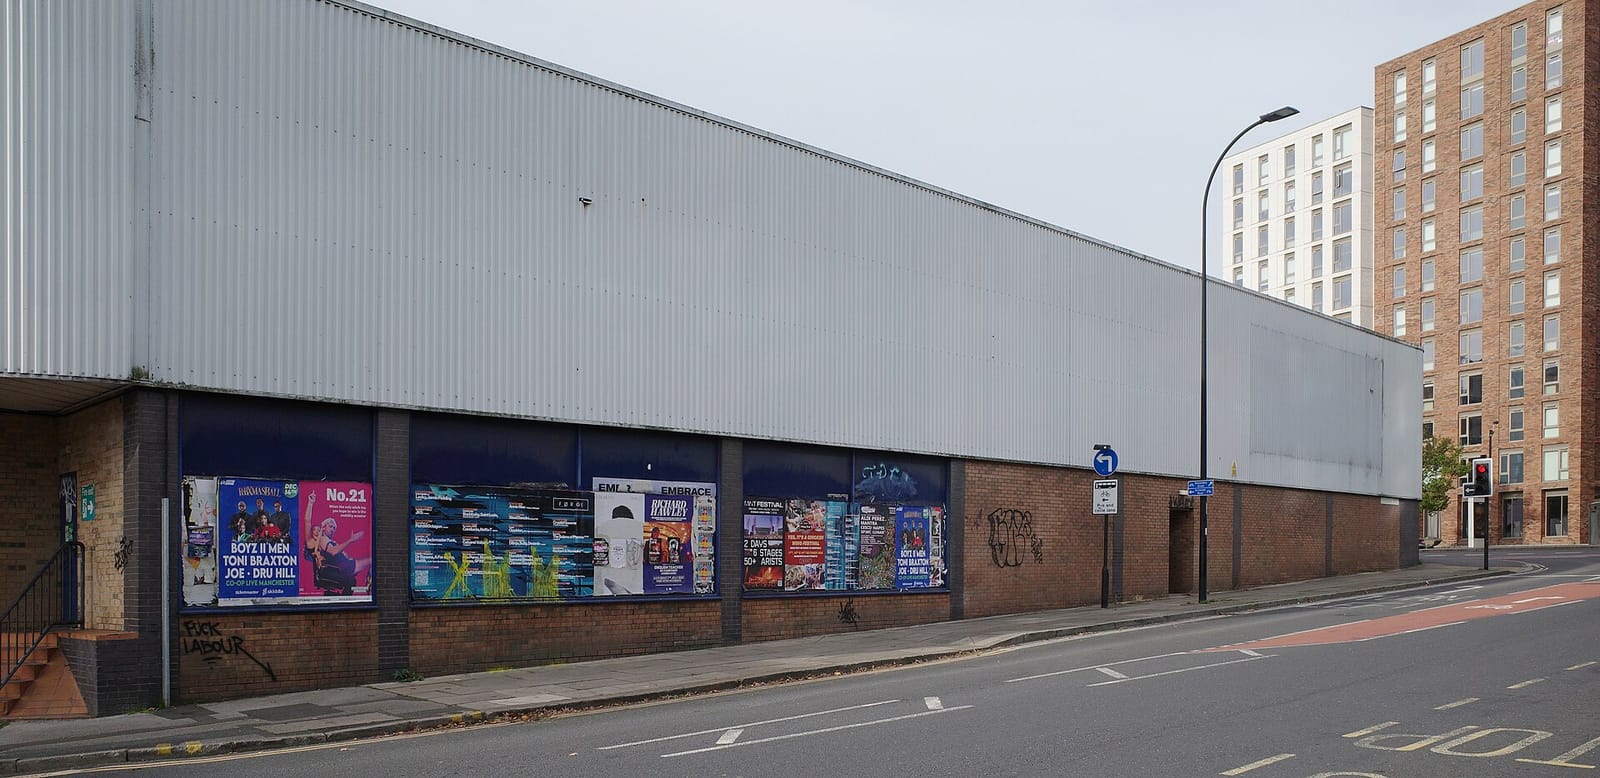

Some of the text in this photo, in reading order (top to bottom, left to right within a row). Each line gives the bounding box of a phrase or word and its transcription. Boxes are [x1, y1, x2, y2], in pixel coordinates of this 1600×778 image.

[326, 488, 366, 502] No.21
[661, 486, 711, 496] EMBRACE
[652, 499, 687, 508] RICHARD
[650, 507, 688, 517] HAWLEY
[231, 542, 258, 554] BOYZ
[268, 542, 290, 554] MEN
[744, 540, 767, 548] 2 DAYS
[760, 548, 783, 557] STAGES
[222, 555, 297, 566] TONI BRAXTON
[224, 567, 296, 579] JOE DRU HILL
[226, 579, 245, 587] CO-OP
[183, 620, 222, 637] FUCK
